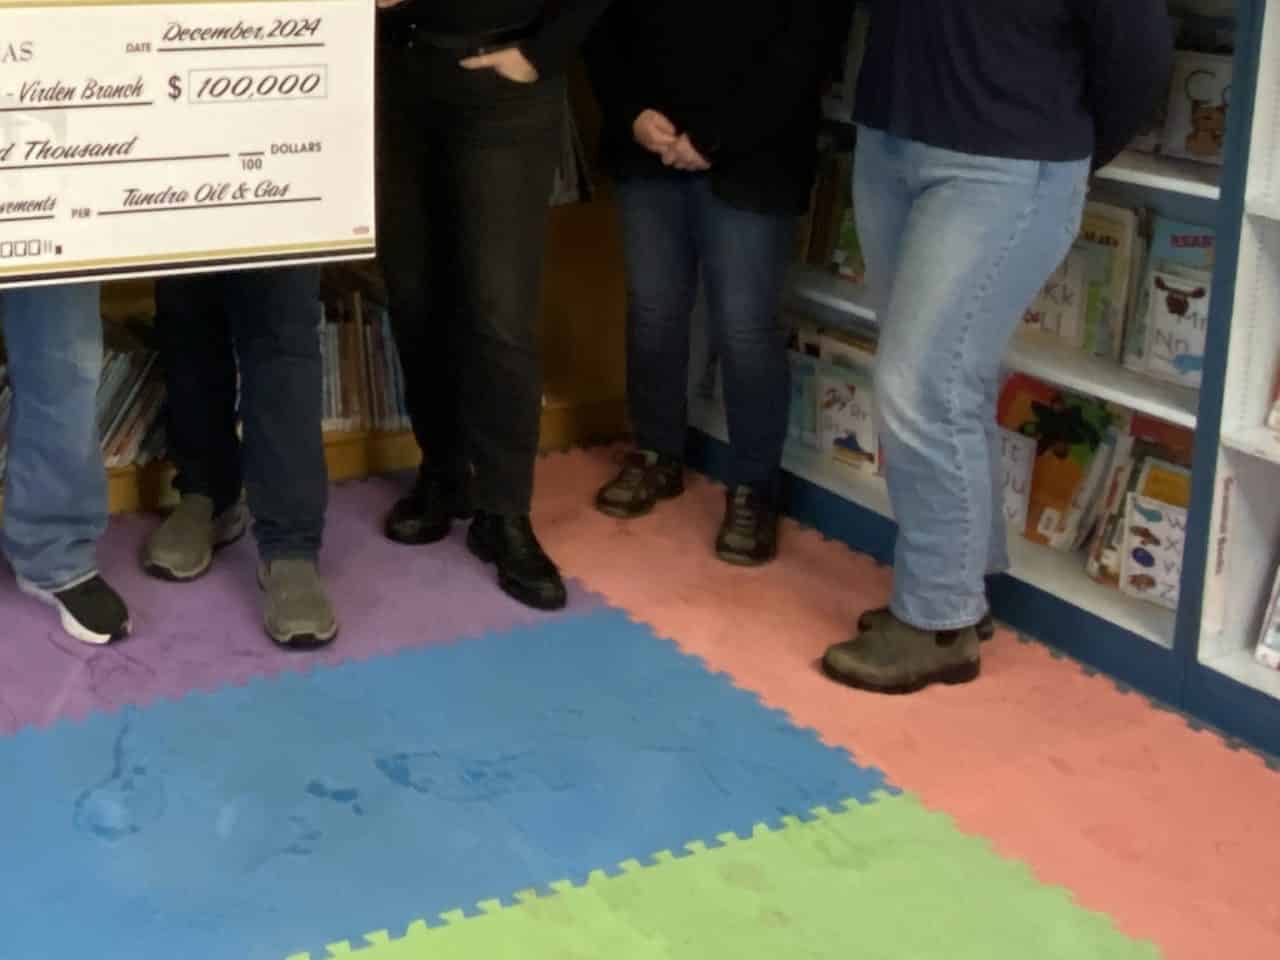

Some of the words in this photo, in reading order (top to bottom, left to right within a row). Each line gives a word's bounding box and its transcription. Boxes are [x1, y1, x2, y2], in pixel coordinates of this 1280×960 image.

[125, 42, 152, 54] DATE
[19, 79, 76, 103] Virden
[80, 75, 145, 101] Branch
[167, 74, 183, 102] $
[196, 72, 322, 100] 100,000
[23, 136, 139, 161] Thousand
[270, 141, 323, 155] DOLLARS
[240, 158, 263, 171] 100
[121, 185, 189, 208] Tundra
[193, 182, 231, 203] Oil
[231, 182, 250, 201] &
[253, 178, 291, 198] Gas
[70, 207, 91, 220] PER
